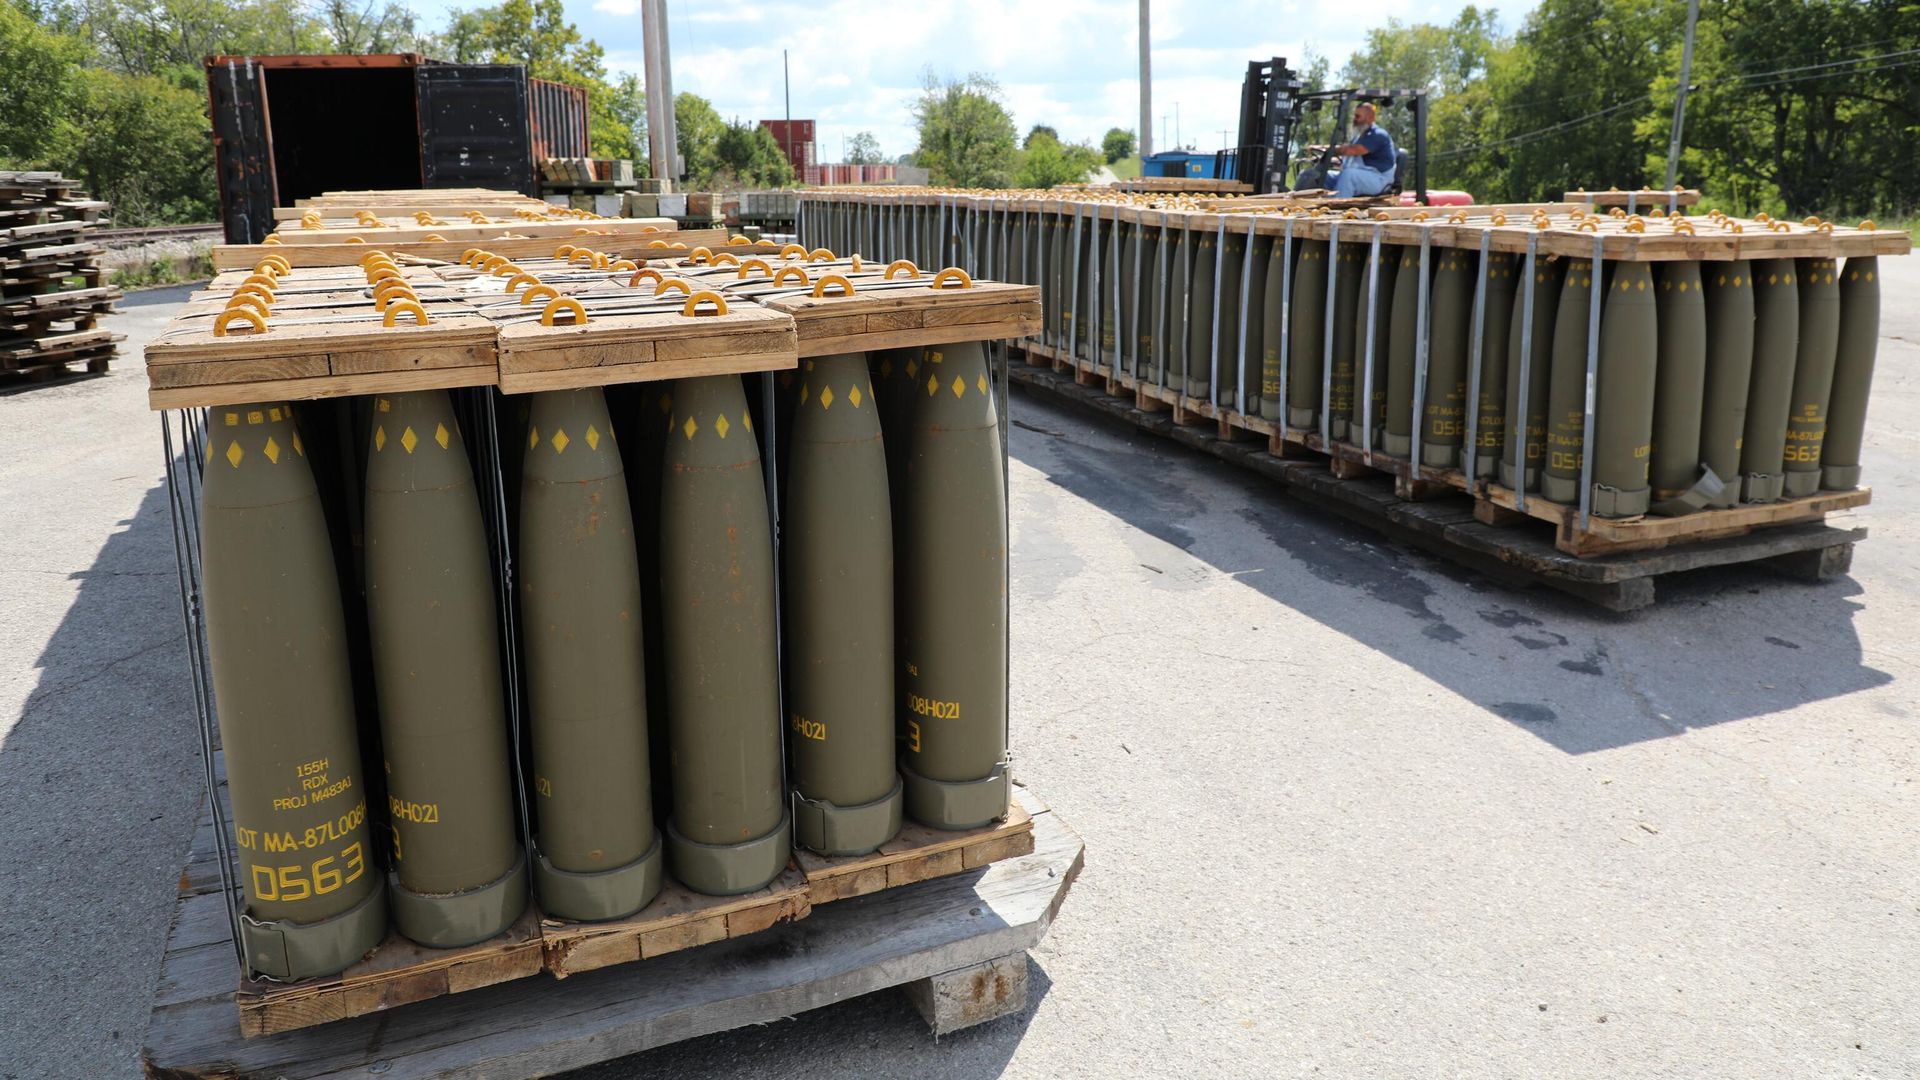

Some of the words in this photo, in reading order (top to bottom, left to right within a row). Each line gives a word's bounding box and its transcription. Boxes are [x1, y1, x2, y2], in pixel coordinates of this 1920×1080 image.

[297, 757, 329, 778] 155H
[303, 773, 329, 791] RDX
[273, 795, 307, 811] PROJ
